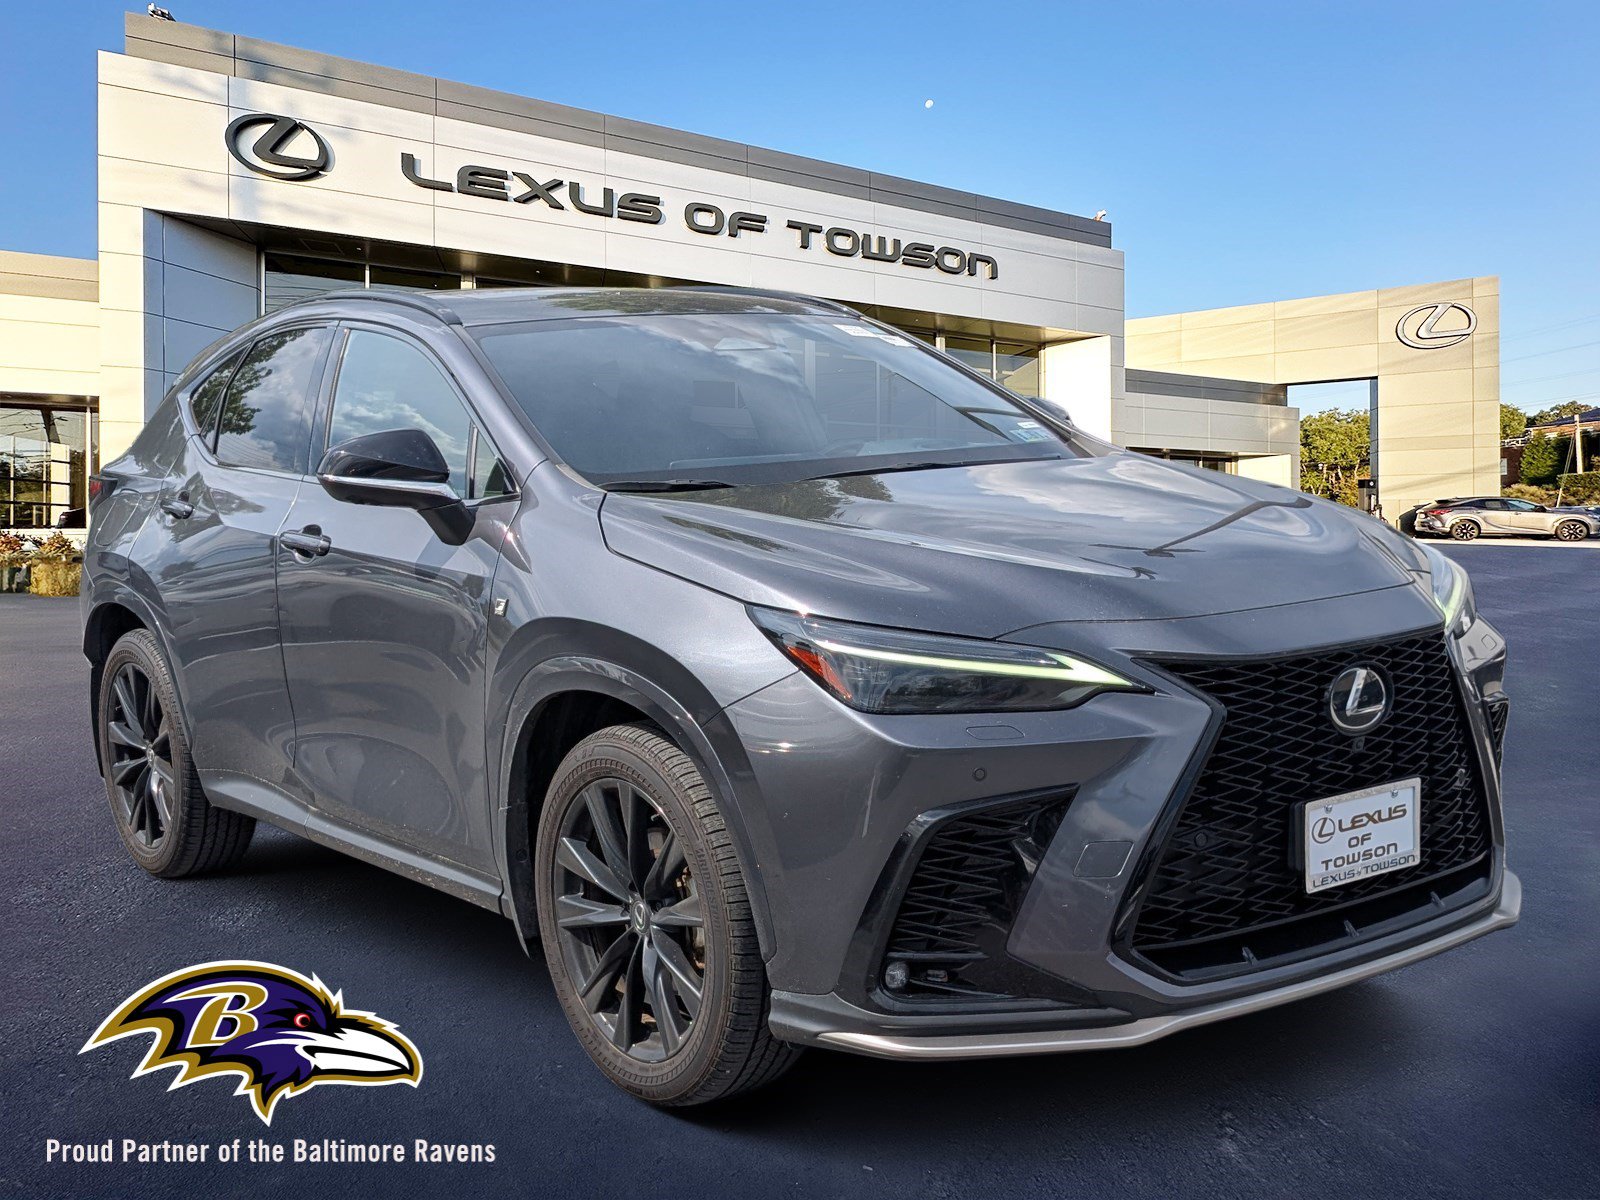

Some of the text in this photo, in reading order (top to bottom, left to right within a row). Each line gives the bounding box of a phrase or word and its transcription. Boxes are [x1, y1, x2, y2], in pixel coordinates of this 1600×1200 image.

[401, 152, 998, 280] LEXUS OF TOWSON
[1338, 804, 1407, 833] LEXUS
[1348, 833, 1372, 849] OF
[1313, 870, 1355, 888] LEXUS
[1363, 854, 1416, 875] TOWSON
[1321, 843, 1398, 871] TOWSON
